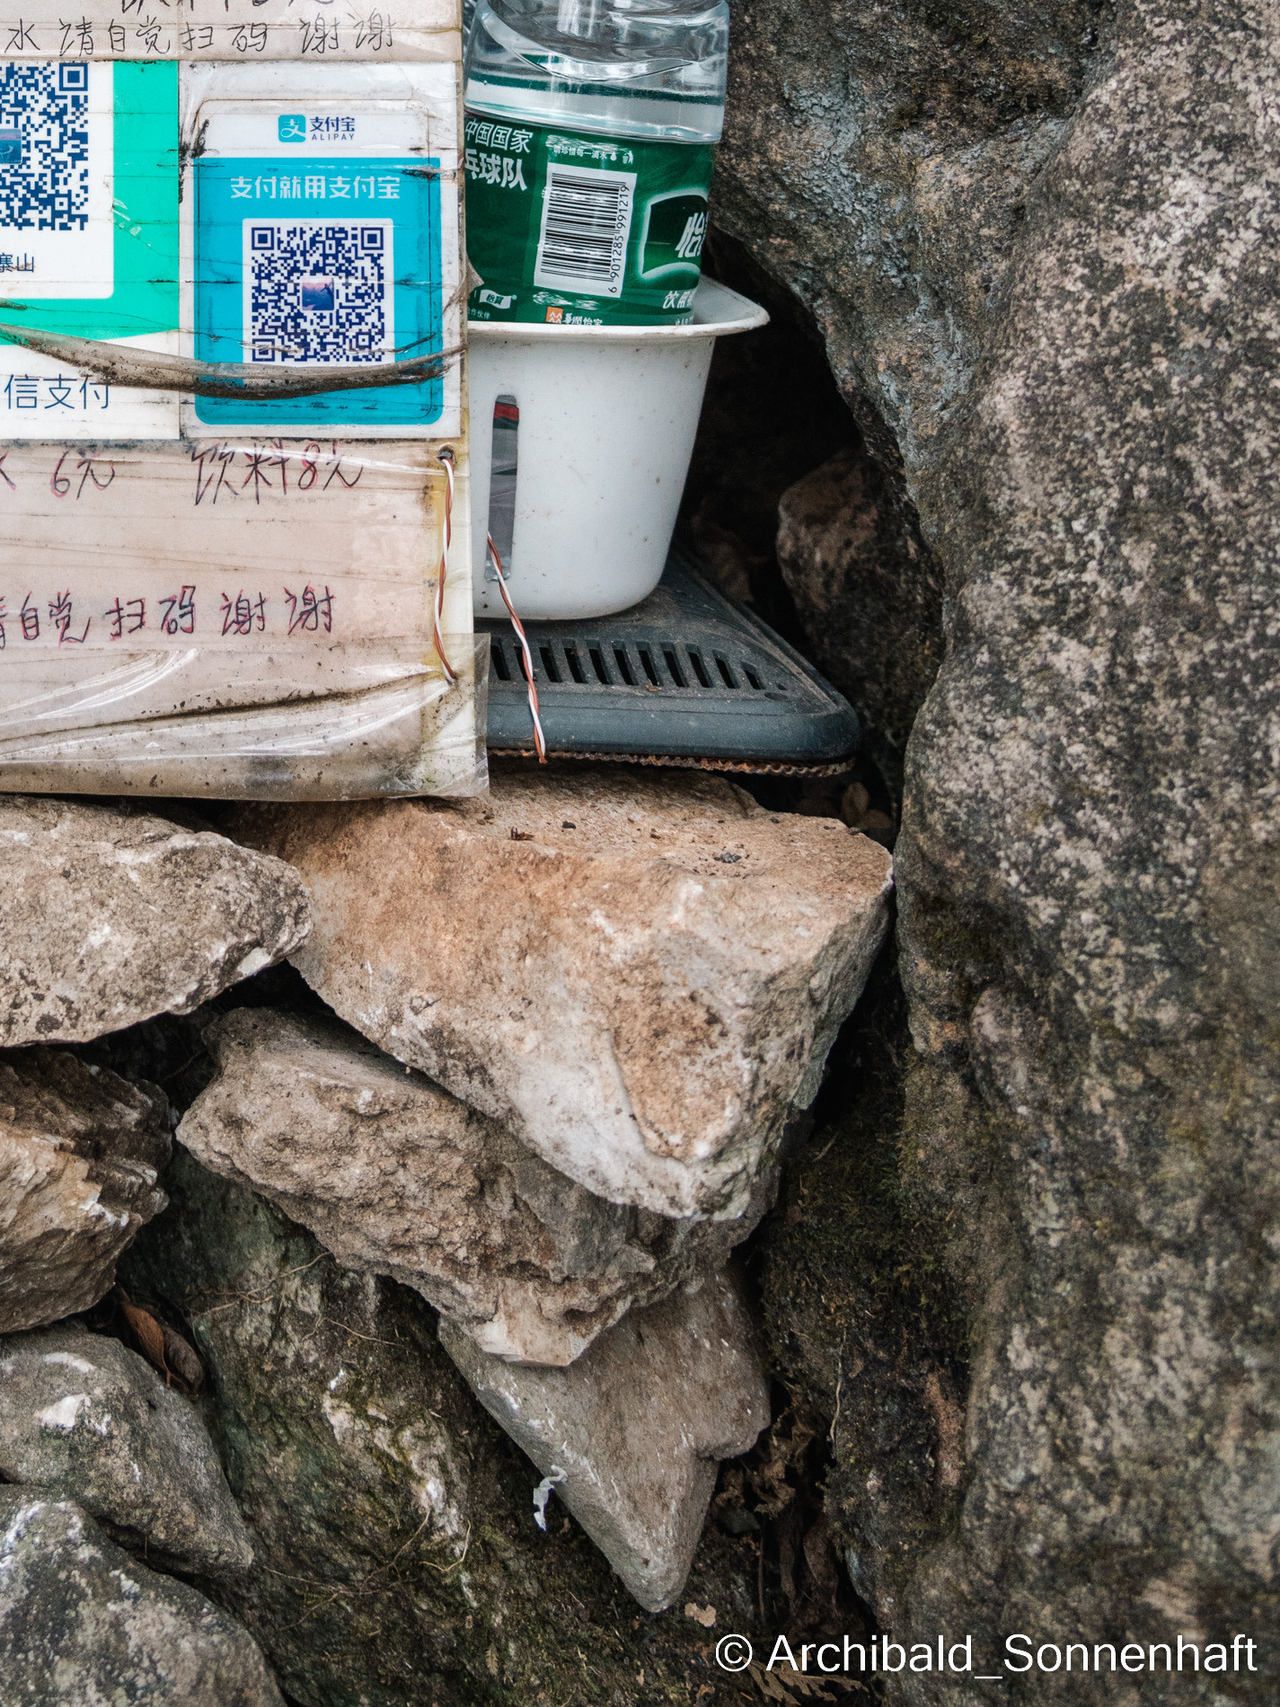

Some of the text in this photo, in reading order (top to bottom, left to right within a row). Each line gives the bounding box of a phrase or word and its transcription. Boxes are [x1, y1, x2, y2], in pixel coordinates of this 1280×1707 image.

[309, 116, 356, 132] 支付宝
[311, 133, 355, 141] ALIPAY
[465, 119, 533, 153] 中国国家
[230, 175, 401, 199] 支付就用支付宝
